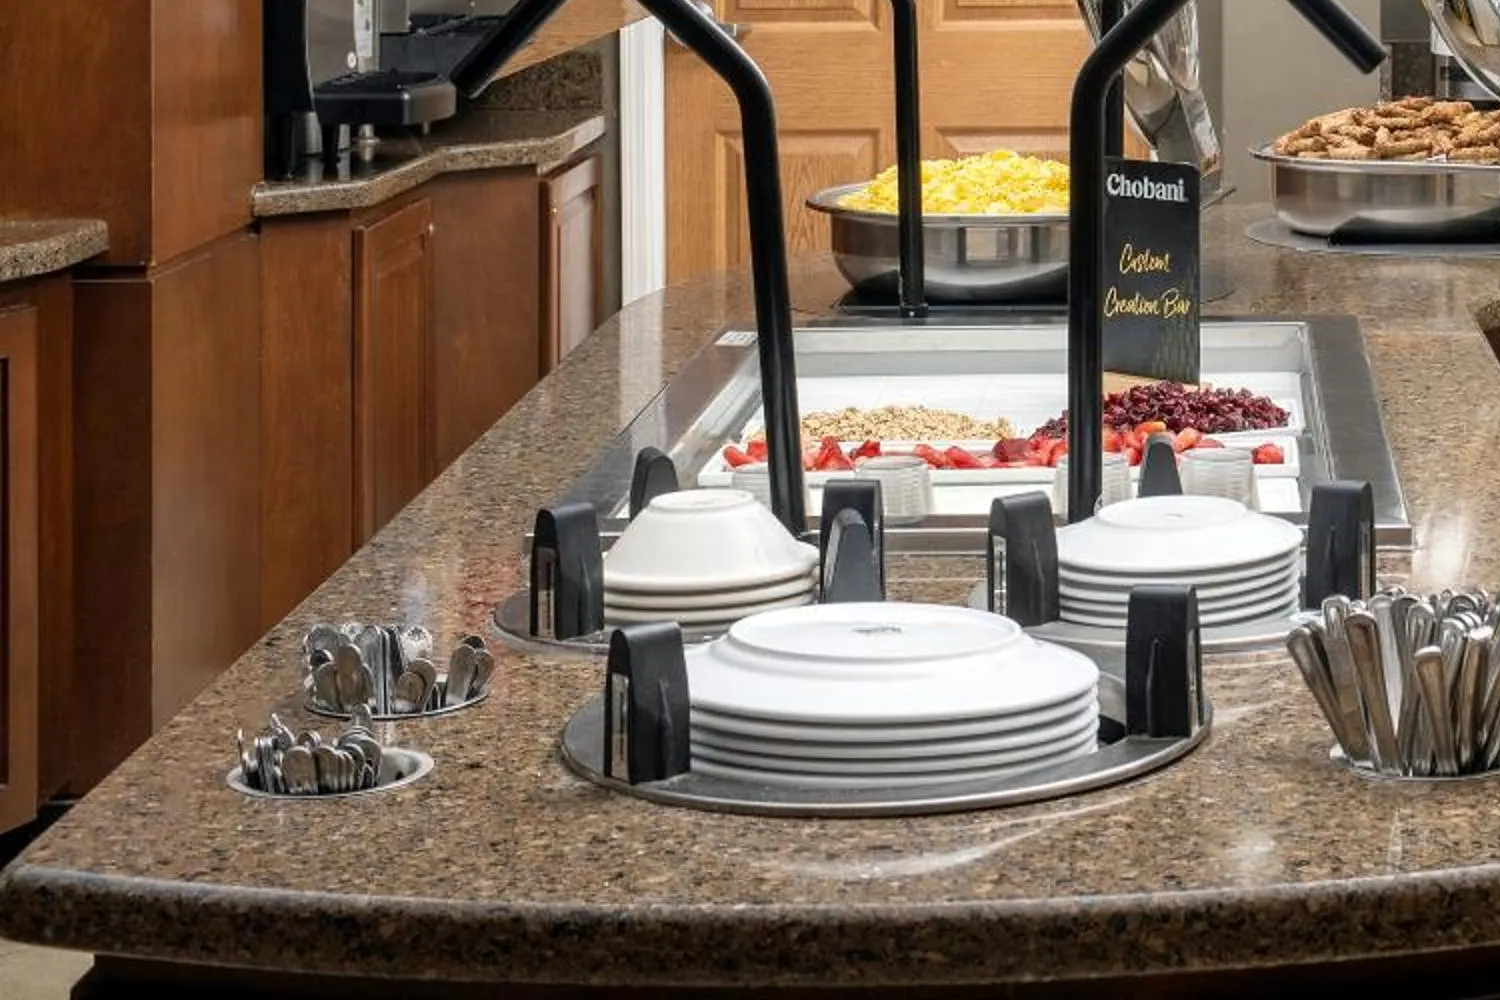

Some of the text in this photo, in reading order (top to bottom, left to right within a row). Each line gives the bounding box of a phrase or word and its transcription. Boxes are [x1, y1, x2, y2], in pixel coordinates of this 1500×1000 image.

[1119, 243, 1171, 274] Custom
[1104, 286, 1192, 319] Creation Bar
